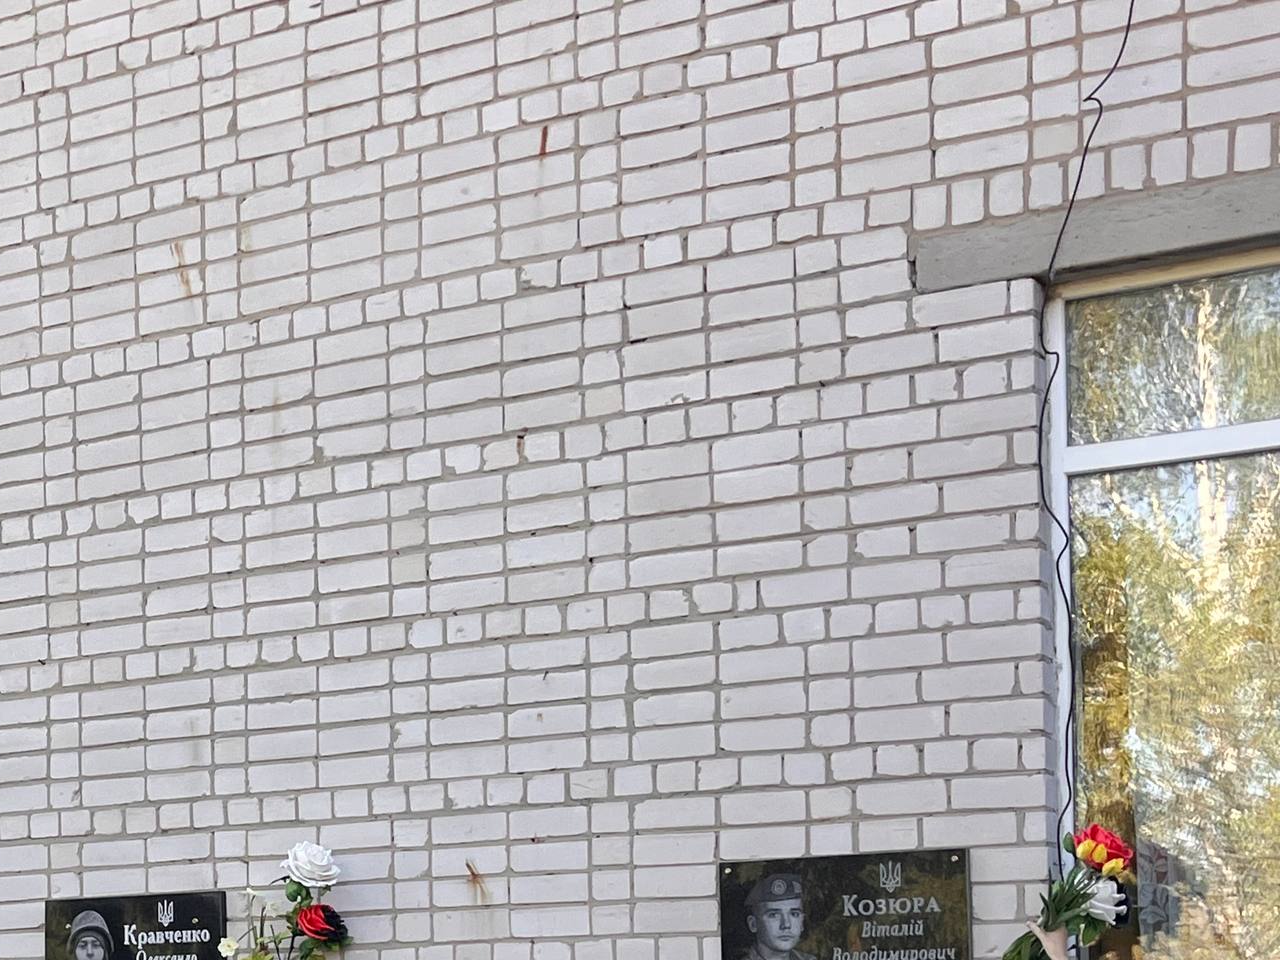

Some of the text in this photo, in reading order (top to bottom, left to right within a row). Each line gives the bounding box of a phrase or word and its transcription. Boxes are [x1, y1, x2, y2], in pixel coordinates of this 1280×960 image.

[842, 895, 941, 917] КОЗЮРА
[123, 924, 211, 949] Кравченко
[862, 919, 924, 938] Віталій
